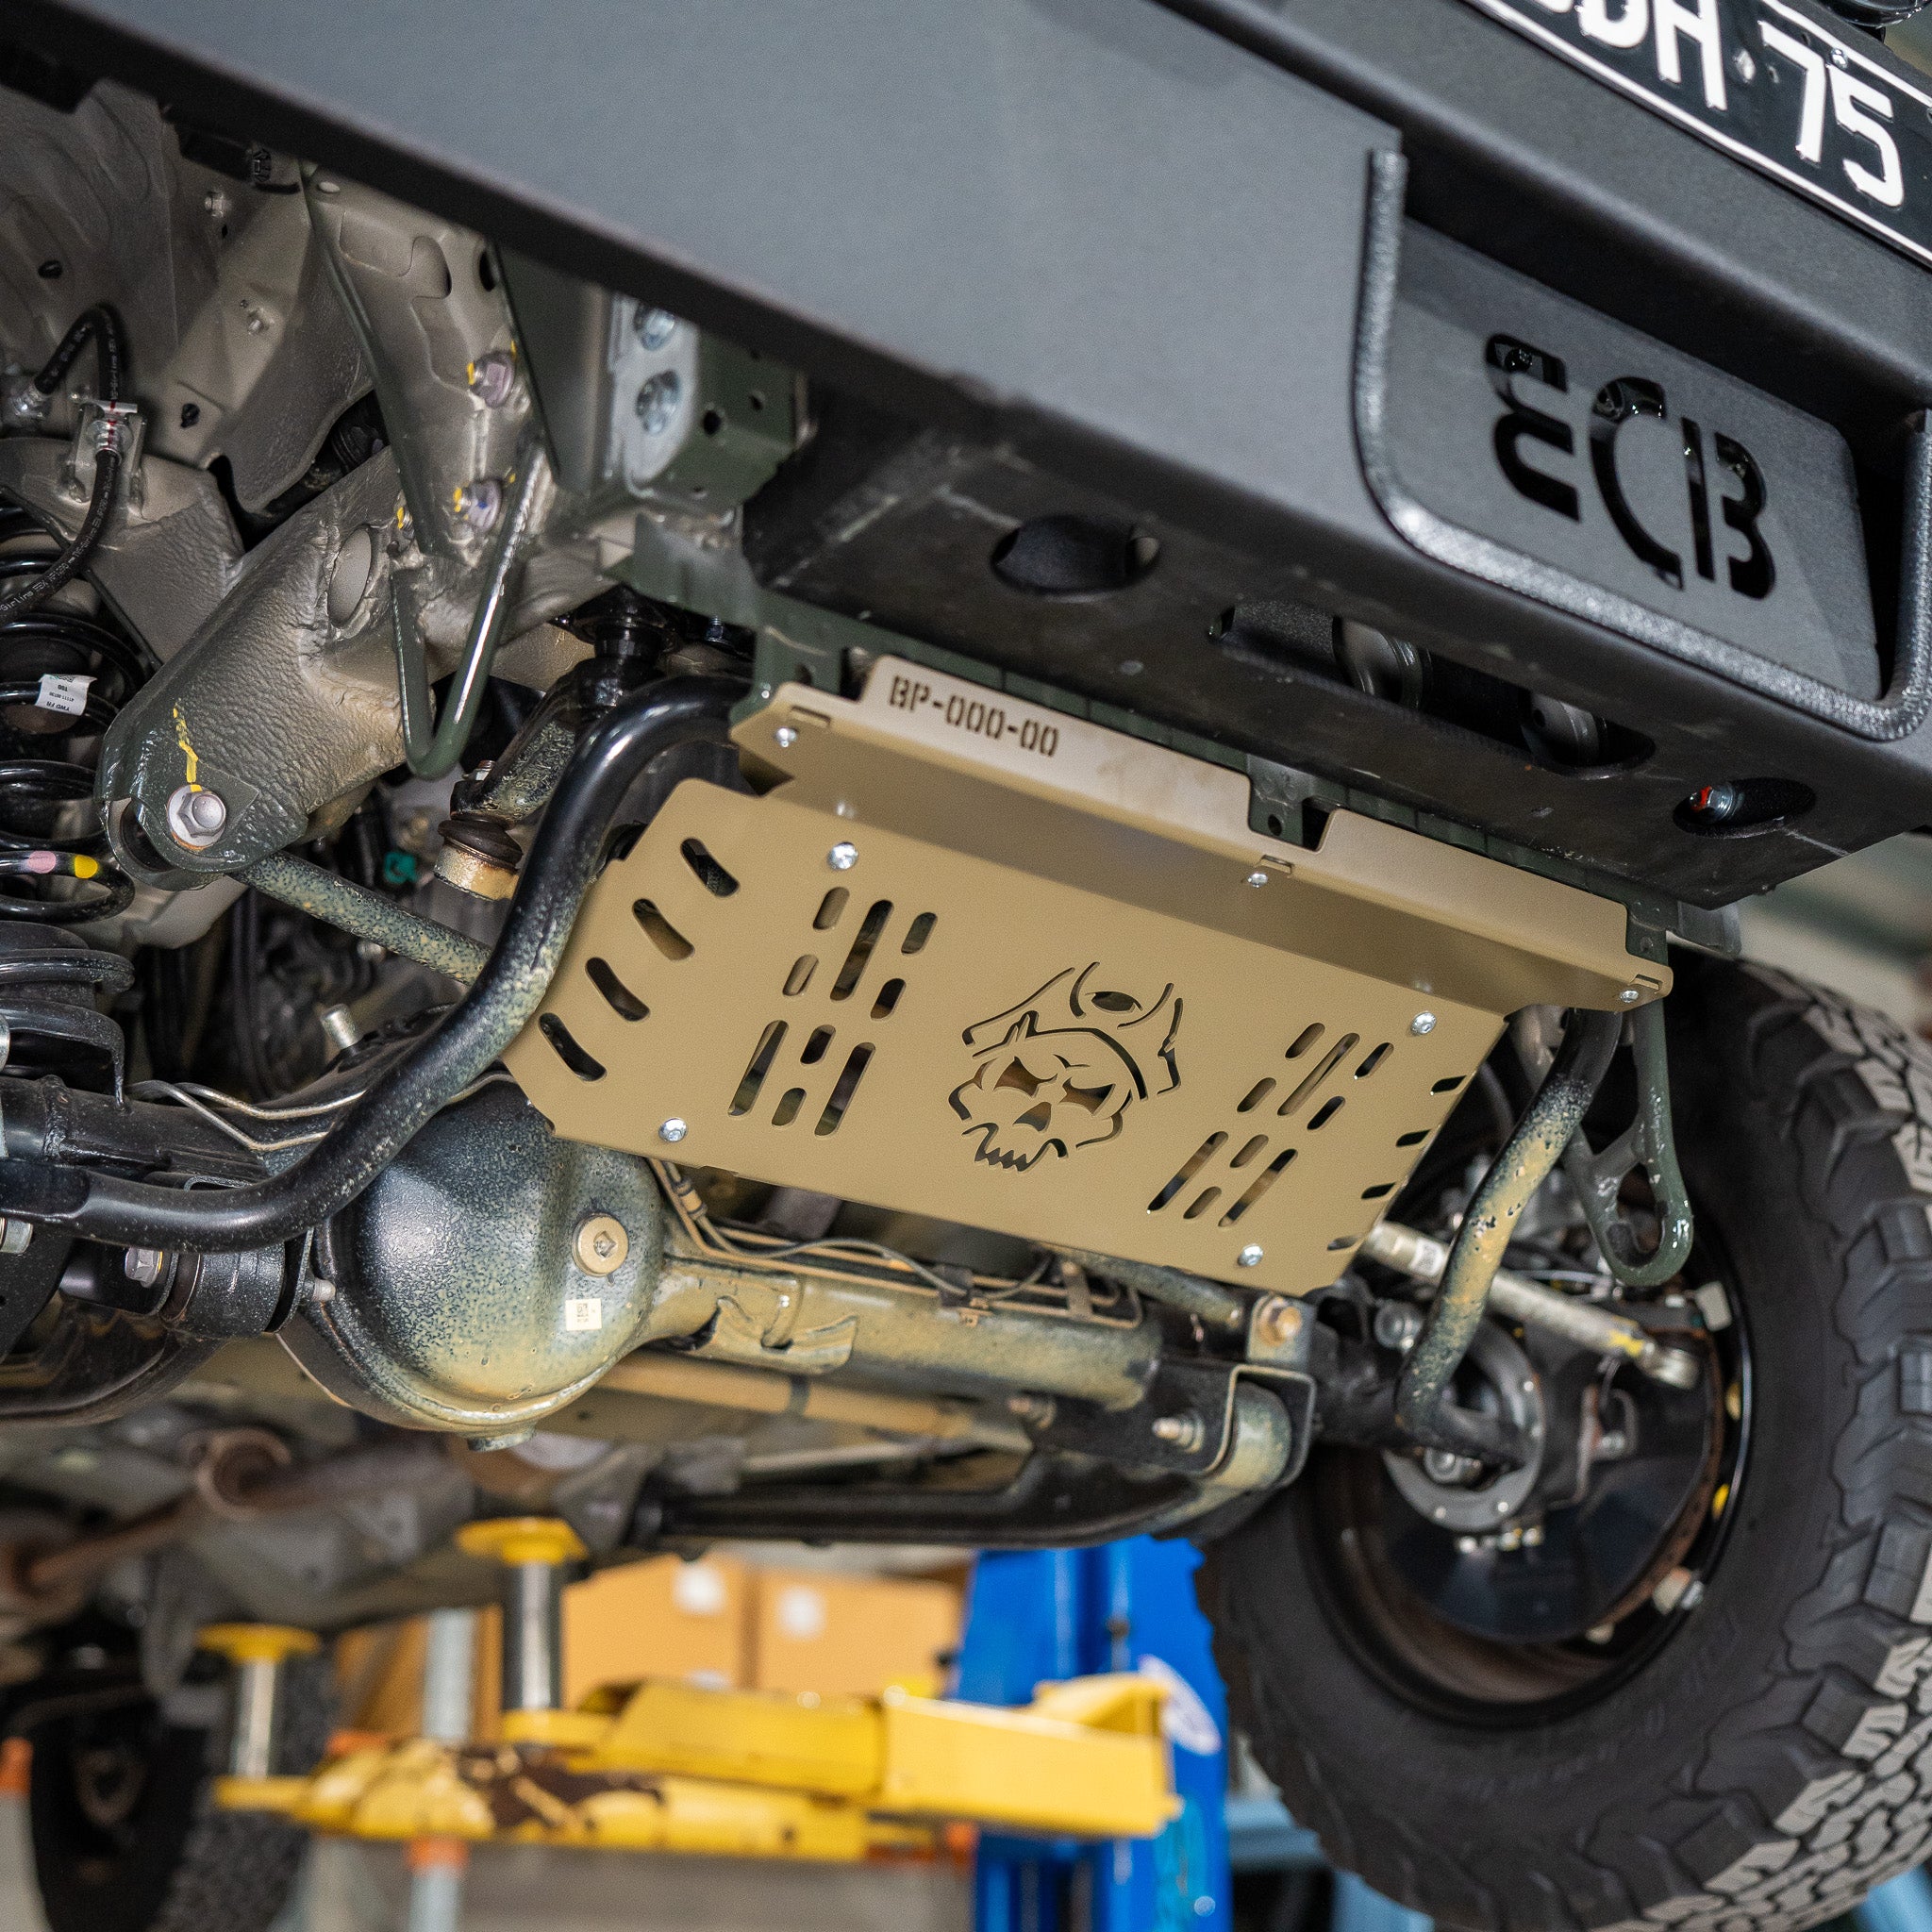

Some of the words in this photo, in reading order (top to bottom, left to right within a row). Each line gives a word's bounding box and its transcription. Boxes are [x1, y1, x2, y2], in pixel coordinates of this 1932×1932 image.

[1757, 21, 1904, 207] 75
[1485, 333, 1775, 600] ECB
[889, 675, 1059, 757] BP-000-00
